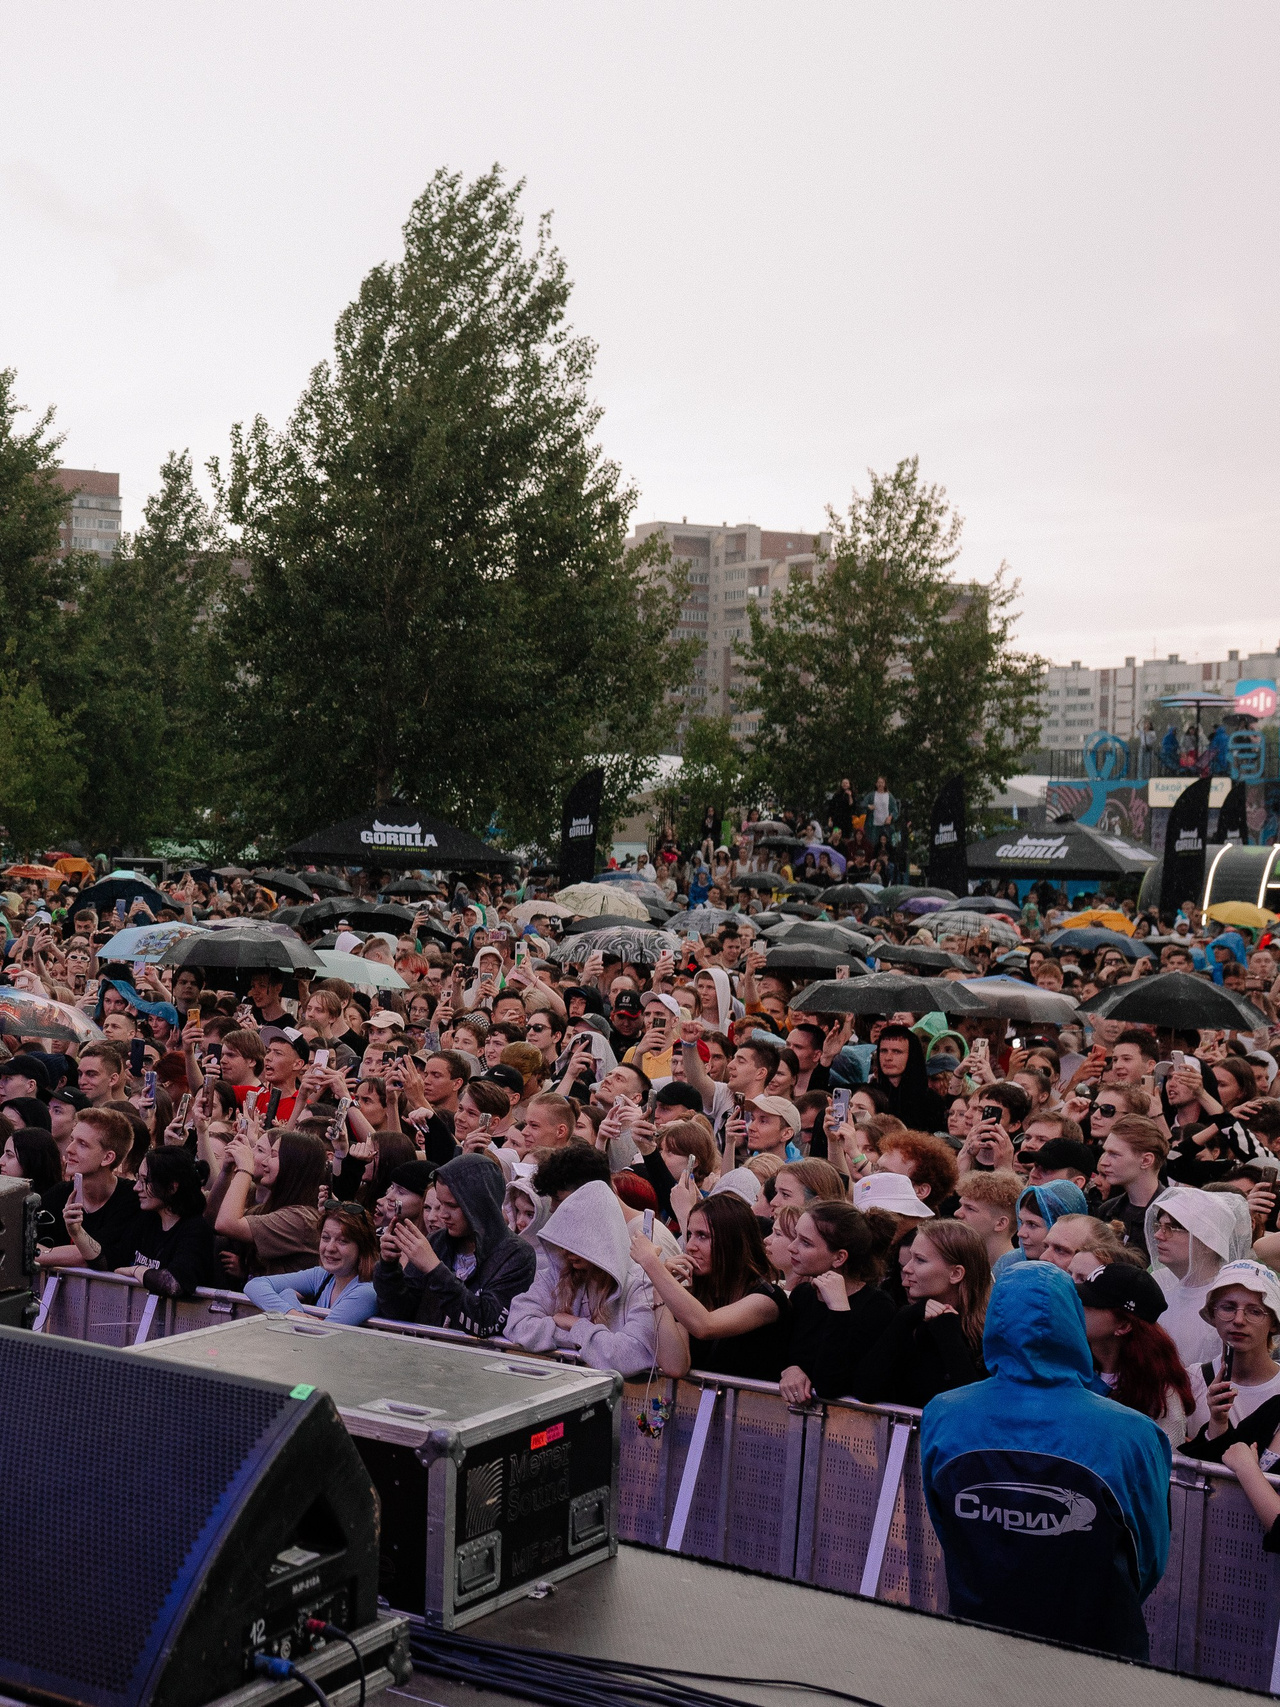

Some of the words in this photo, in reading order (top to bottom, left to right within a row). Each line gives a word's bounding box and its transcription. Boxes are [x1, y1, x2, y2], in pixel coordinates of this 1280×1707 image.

[360, 830, 438, 847] GORILLA
[995, 844, 1070, 859] GORILLA
[508, 1441, 572, 1487] Meyer
[507, 1469, 571, 1522] Sound
[249, 1617, 267, 1646] 12
